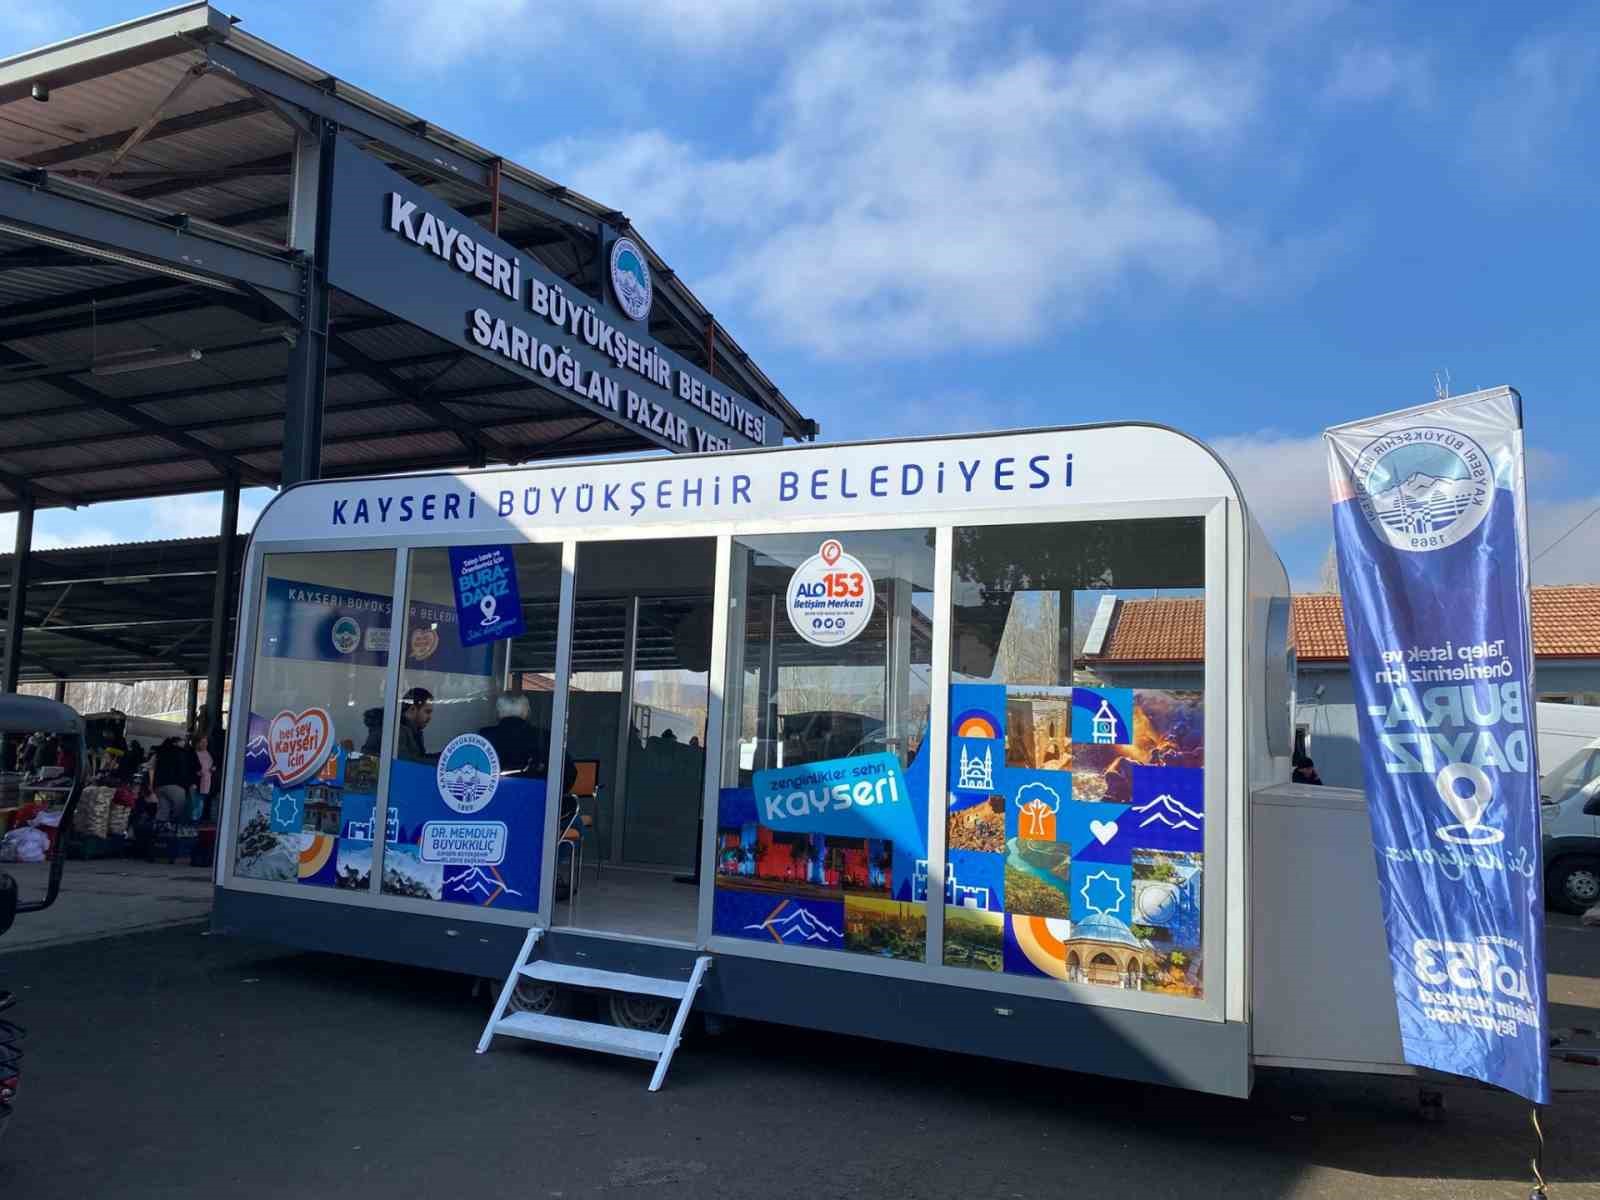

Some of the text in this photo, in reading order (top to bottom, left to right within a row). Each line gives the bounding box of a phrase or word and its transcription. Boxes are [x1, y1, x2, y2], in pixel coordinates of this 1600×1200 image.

[388, 192, 520, 300] KAYSERİ
[531, 282, 671, 390] BÜYÜKŞEHİR
[679, 370, 767, 446] BELEDİYESİ
[472, 308, 619, 412] SARIOĞLAN
[626, 388, 689, 448] PAZAR
[332, 453, 1075, 525] KAYSERİ BÜYÜKŞEHİR BELEDİYESİ
[288, 588, 343, 607] KAYSERİ
[827, 598, 864, 609] Merkezi
[431, 828, 498, 840] DR. MEMDUH
[432, 839, 495, 854] BÜYÜKKILIÇ
